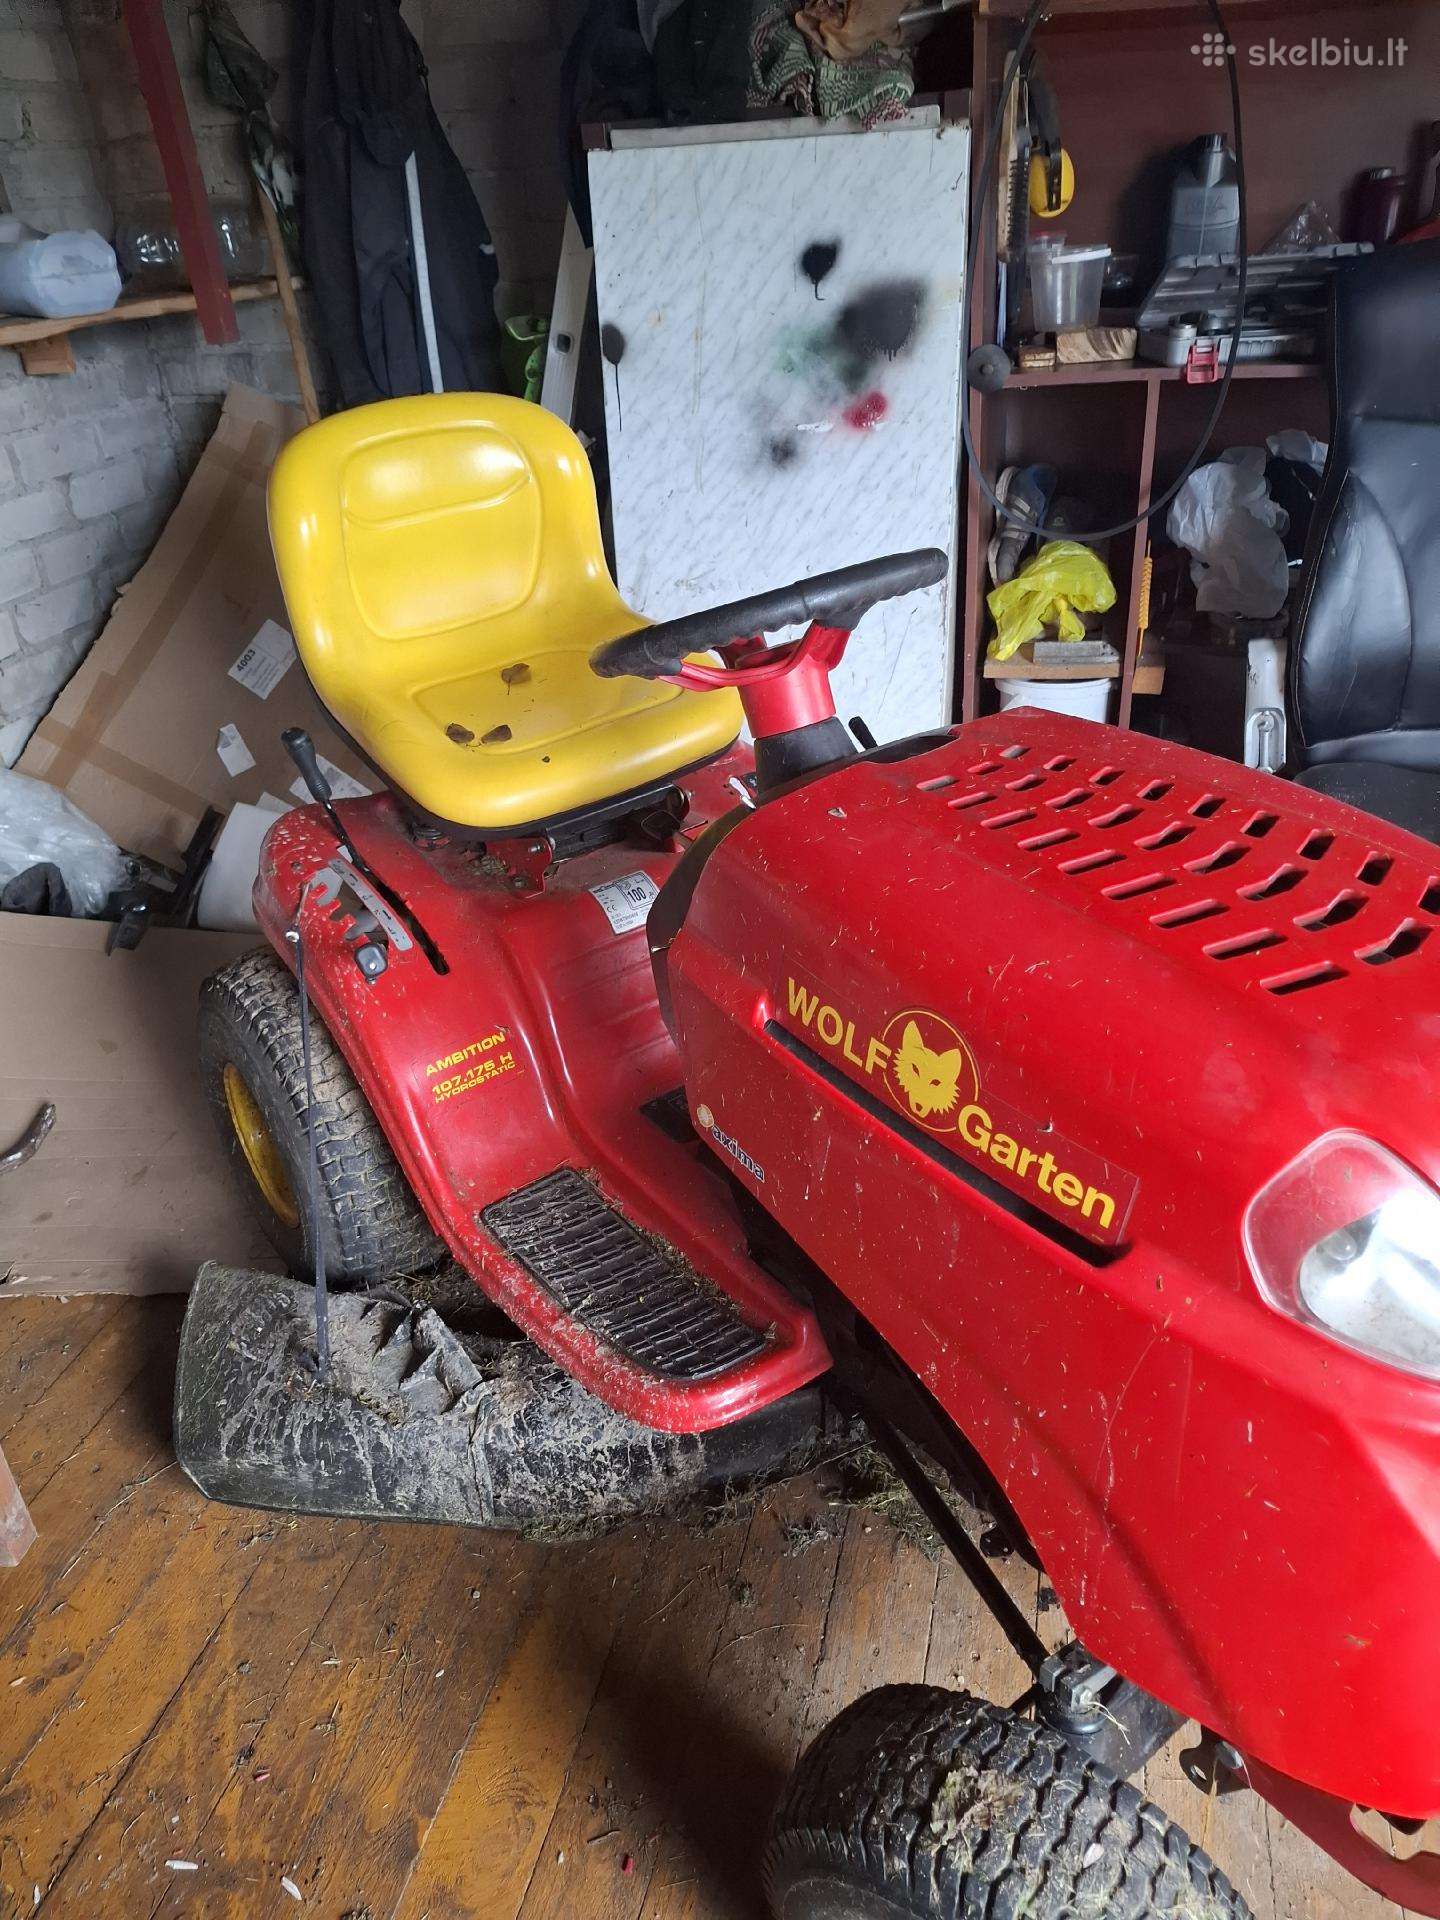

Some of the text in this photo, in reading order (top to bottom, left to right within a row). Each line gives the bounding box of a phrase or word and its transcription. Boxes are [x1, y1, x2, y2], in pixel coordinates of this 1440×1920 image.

[236, 649, 256, 672] 4003
[627, 886, 647, 903] 100
[788, 976, 892, 1075] WOLF
[426, 1031, 506, 1077] AMBITION
[432, 1051, 513, 1095] 107.175 H
[435, 1061, 516, 1104] HYDROSTATIC
[958, 1104, 1116, 1229] Garten
